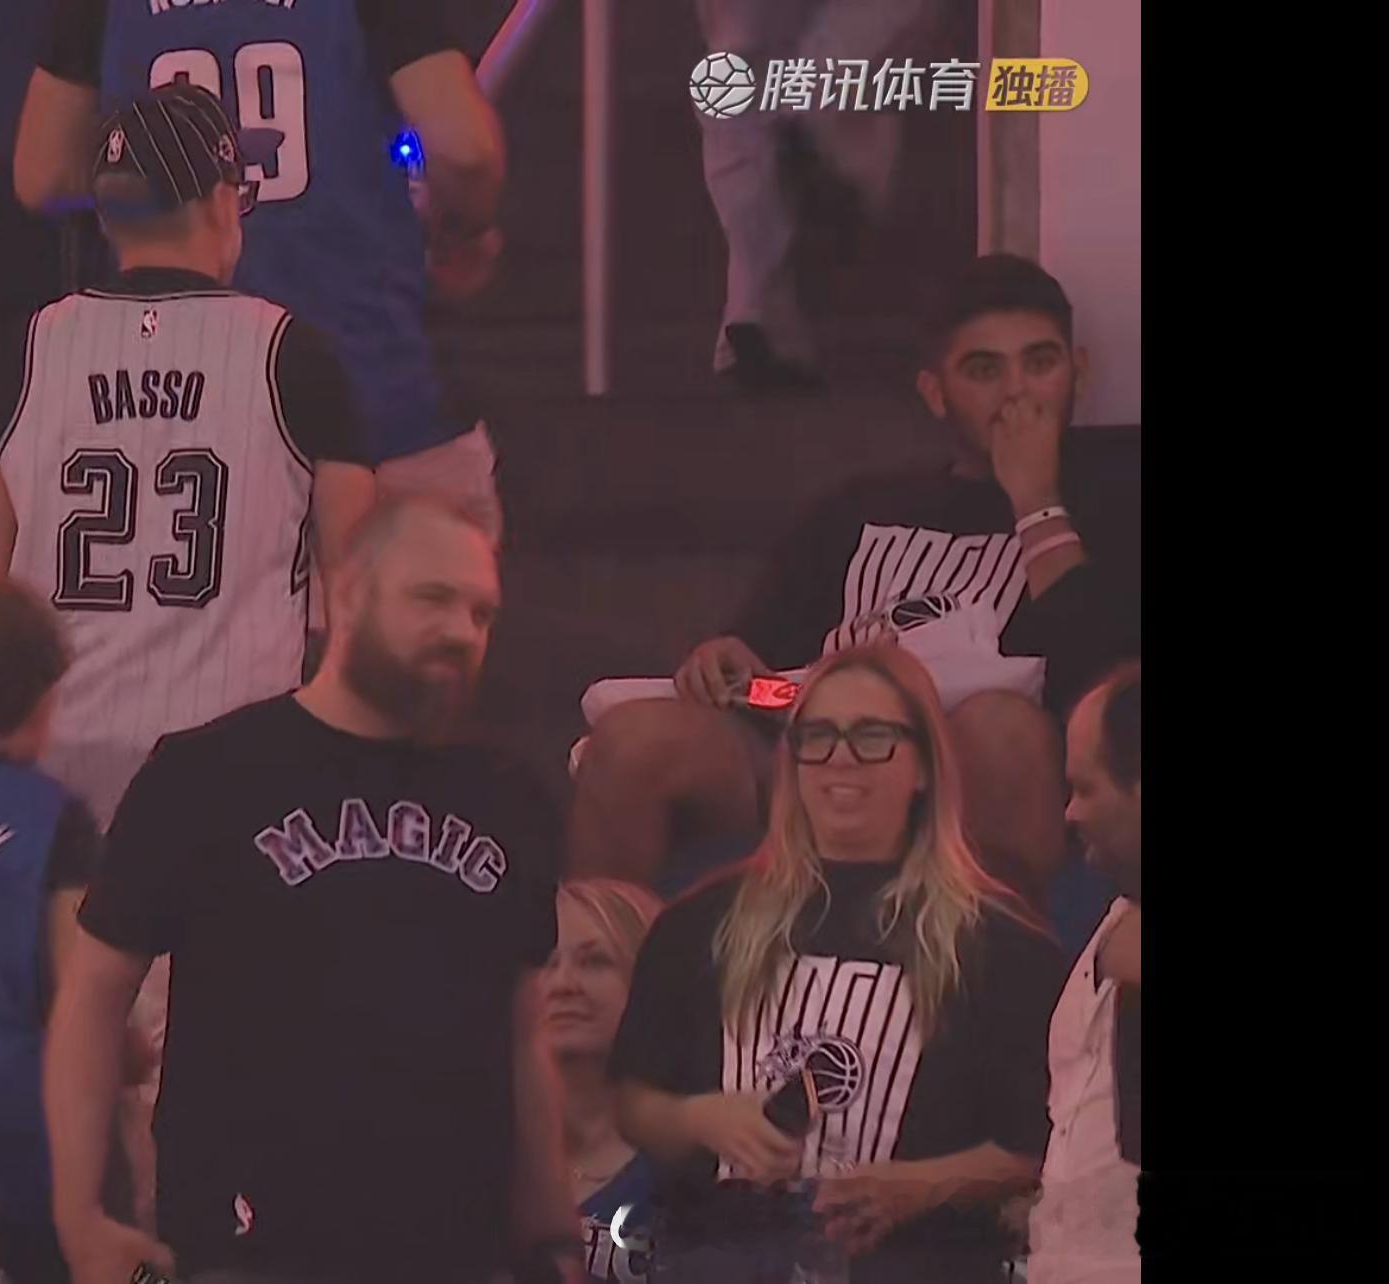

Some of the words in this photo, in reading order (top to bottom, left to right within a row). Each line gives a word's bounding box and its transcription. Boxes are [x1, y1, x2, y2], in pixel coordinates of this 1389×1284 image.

[88, 369, 205, 425] BASSO
[51, 448, 229, 612] 23
[254, 798, 507, 892] MAGIC
